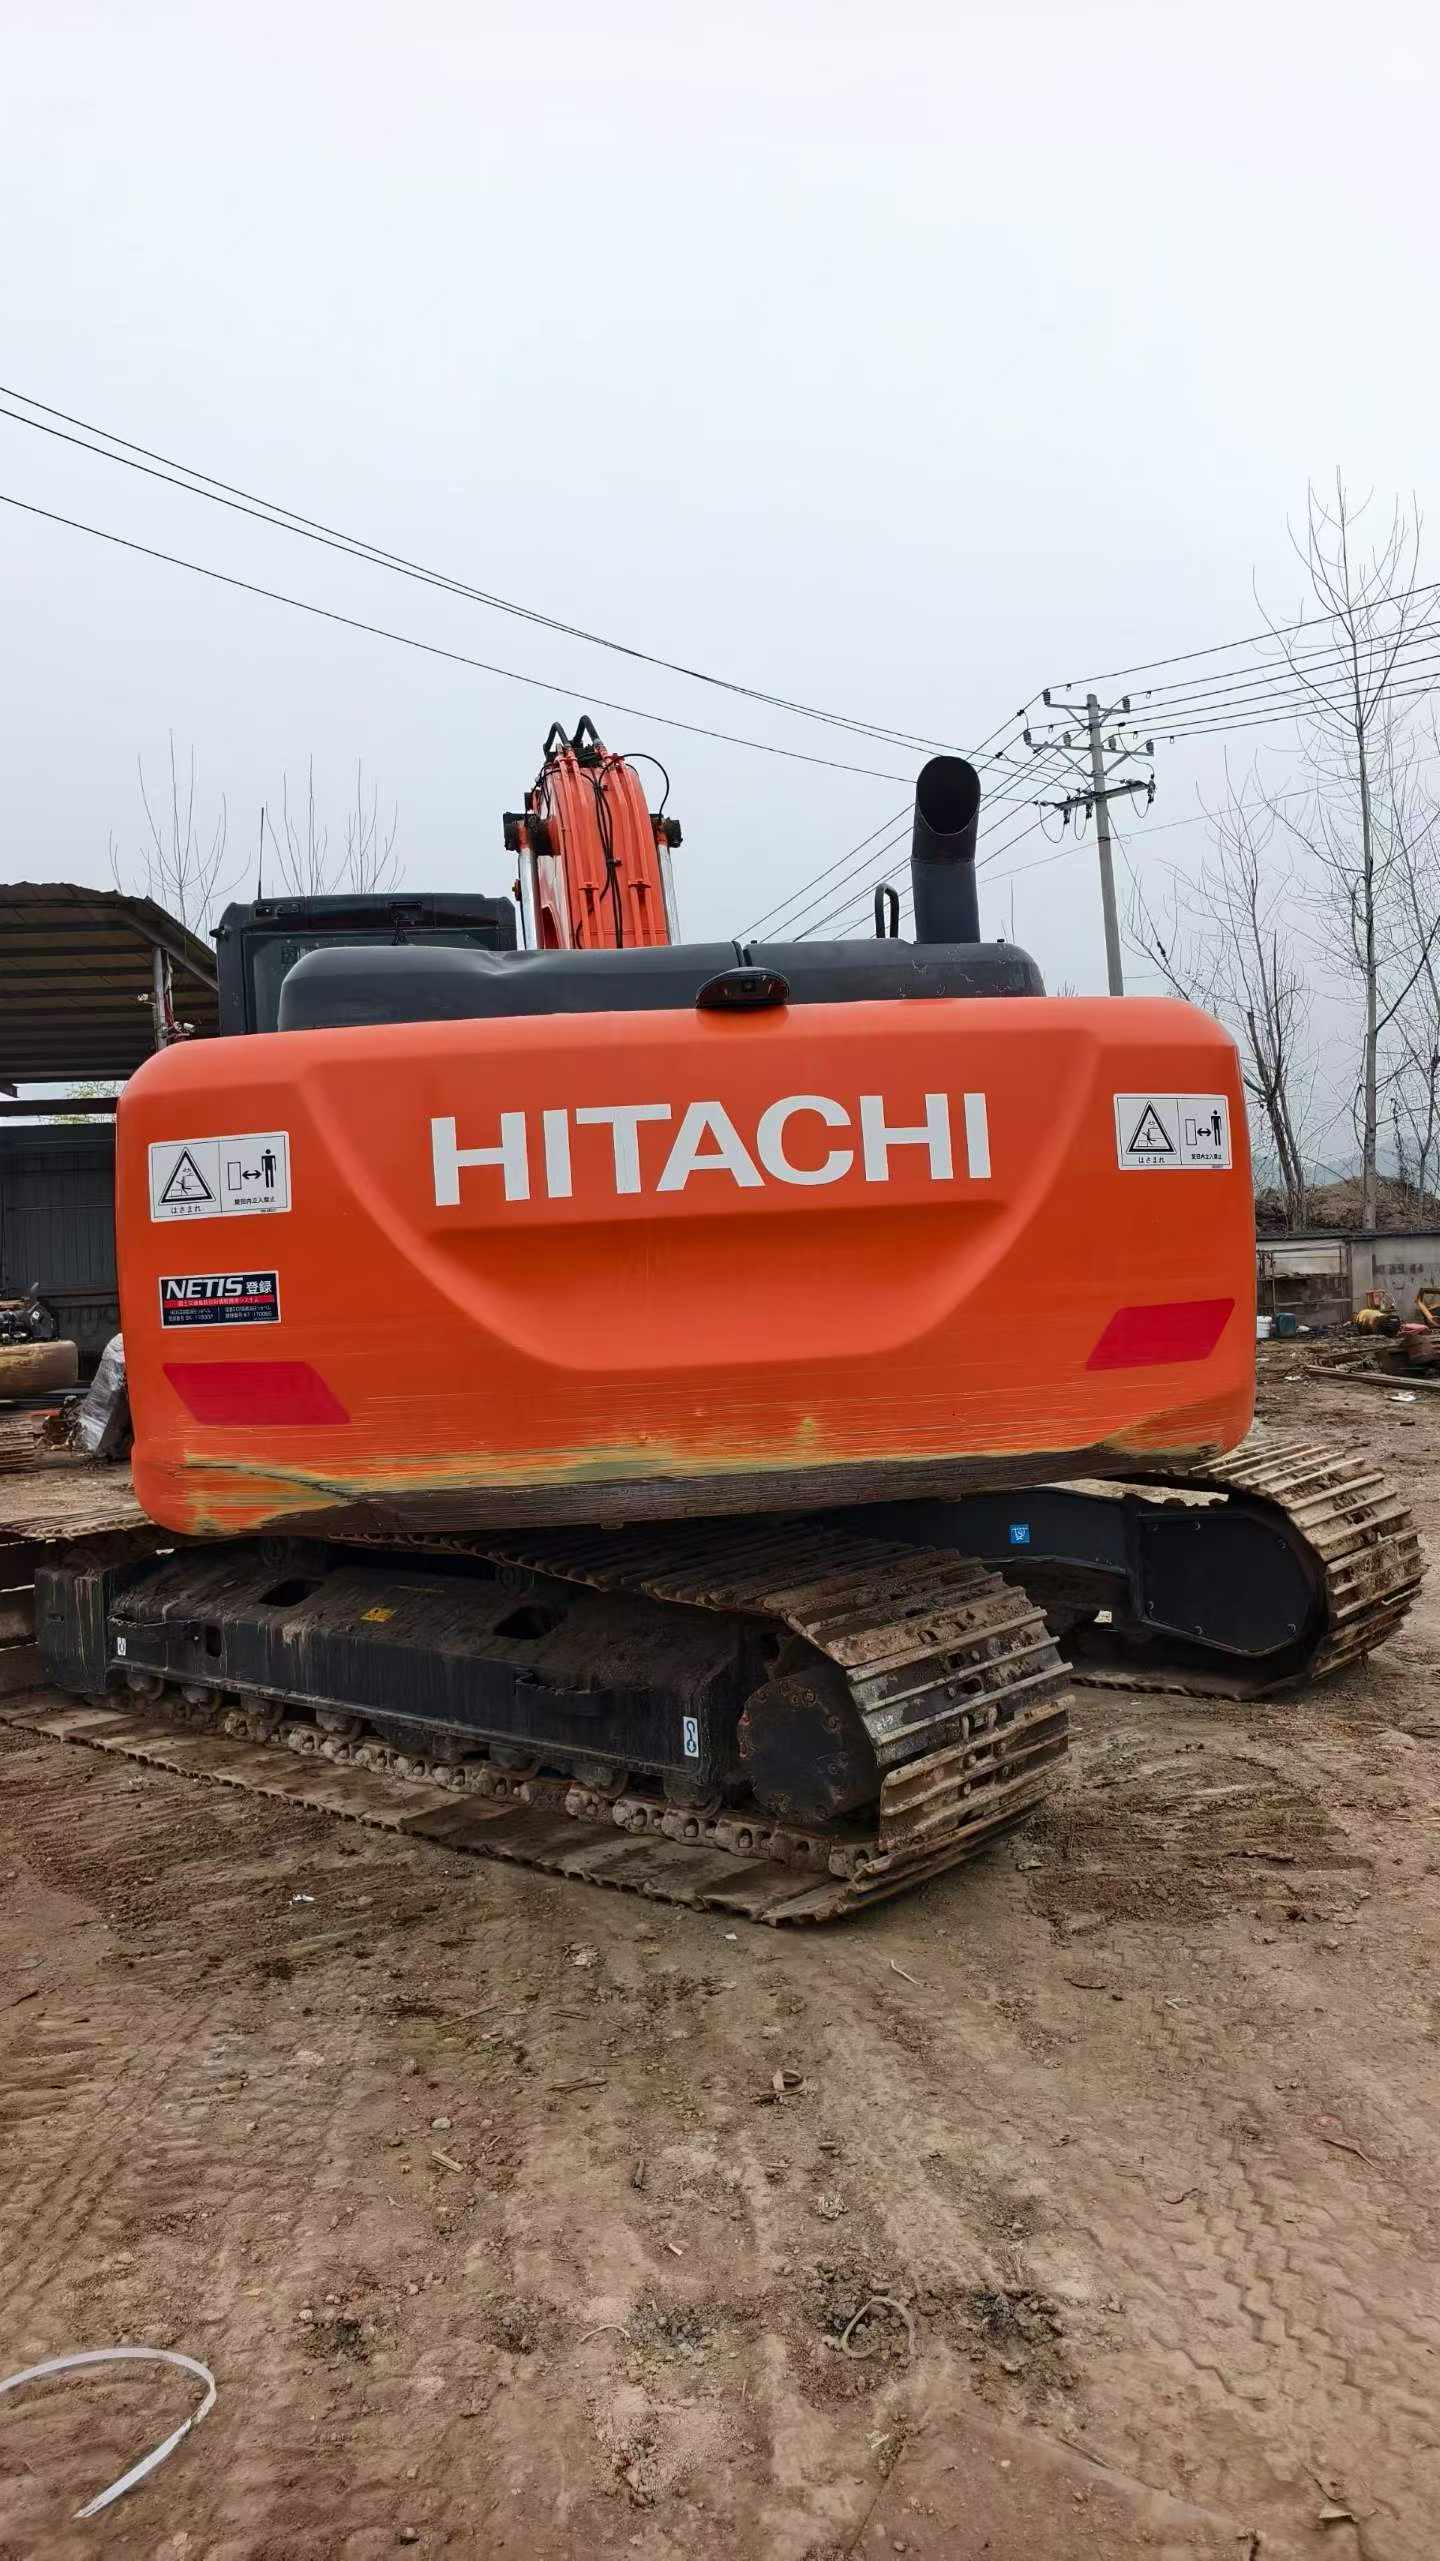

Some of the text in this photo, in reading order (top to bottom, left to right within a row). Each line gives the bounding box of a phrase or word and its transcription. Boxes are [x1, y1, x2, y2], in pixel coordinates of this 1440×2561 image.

[430, 1092, 992, 1207] HITACHI
[1138, 1156, 1166, 1164] はさまれ
[170, 1205, 202, 1214] はさまれ
[166, 1277, 272, 1299] NETIS 登録
